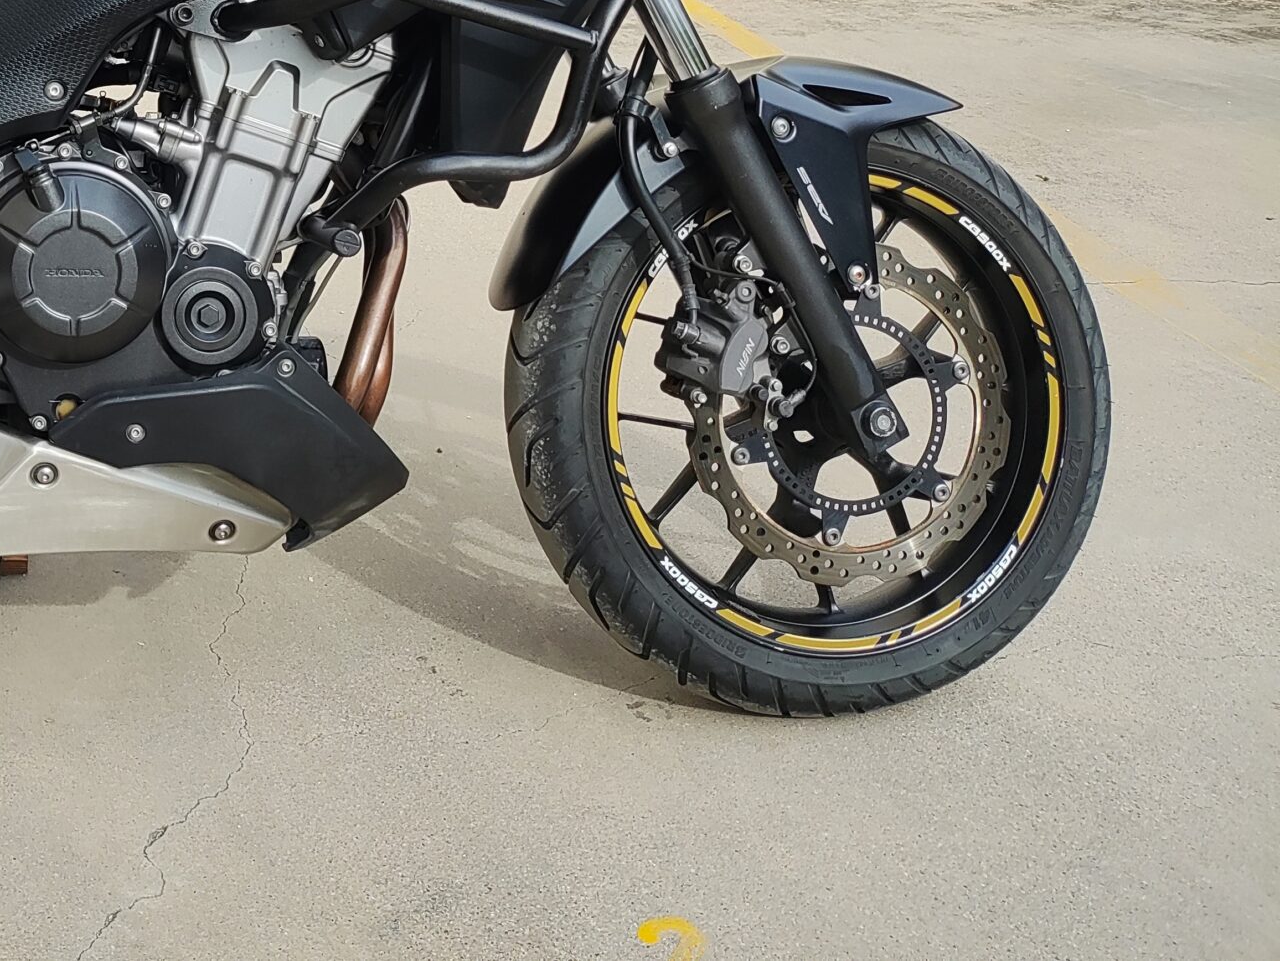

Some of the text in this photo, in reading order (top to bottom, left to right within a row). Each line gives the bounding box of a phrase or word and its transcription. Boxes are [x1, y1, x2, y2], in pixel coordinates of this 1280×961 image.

[958, 215, 1012, 272] CB500X
[44, 268, 105, 278] HONDA
[659, 555, 719, 609] CB500X
[966, 544, 1018, 604] CB500X
